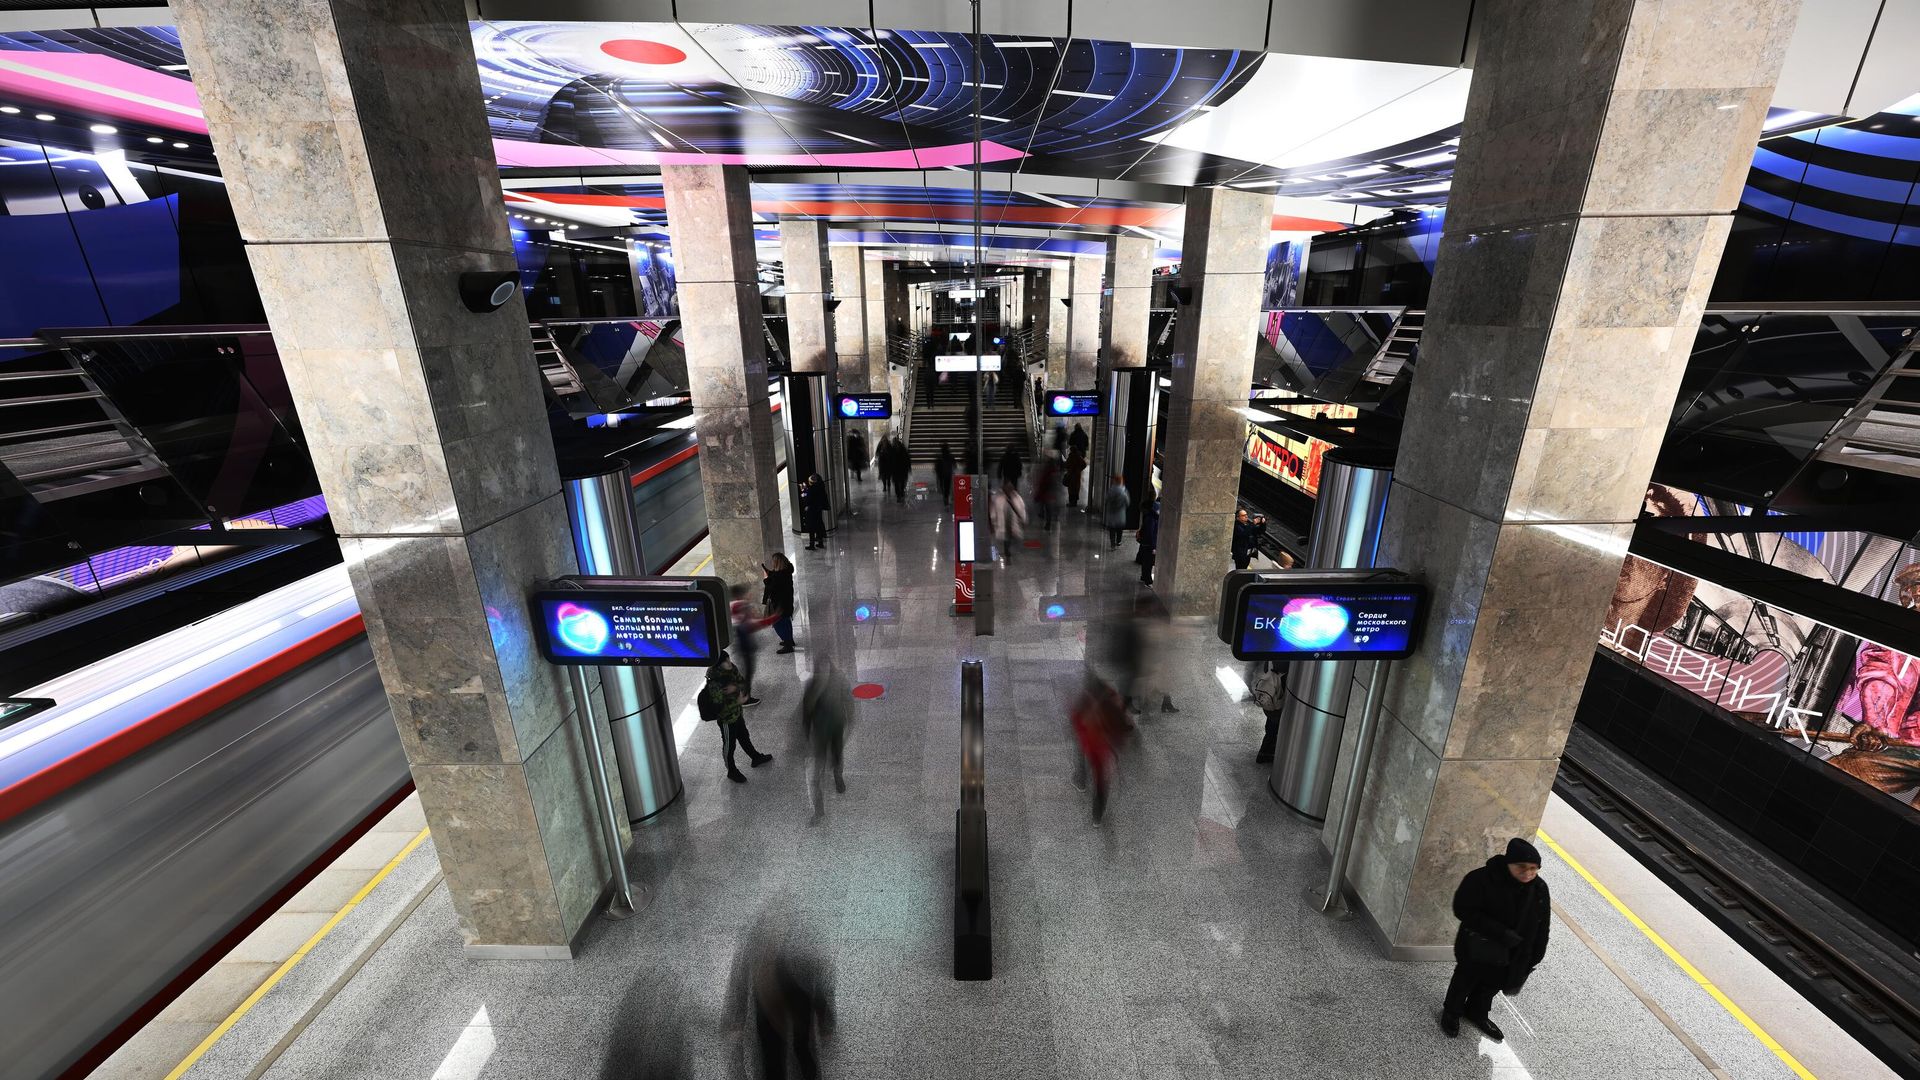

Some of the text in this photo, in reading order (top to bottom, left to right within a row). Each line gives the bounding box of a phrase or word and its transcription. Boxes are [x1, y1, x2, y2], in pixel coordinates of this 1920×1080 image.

[1250, 437, 1298, 478] МЕТРО
[613, 615, 683, 624] Самая большая
